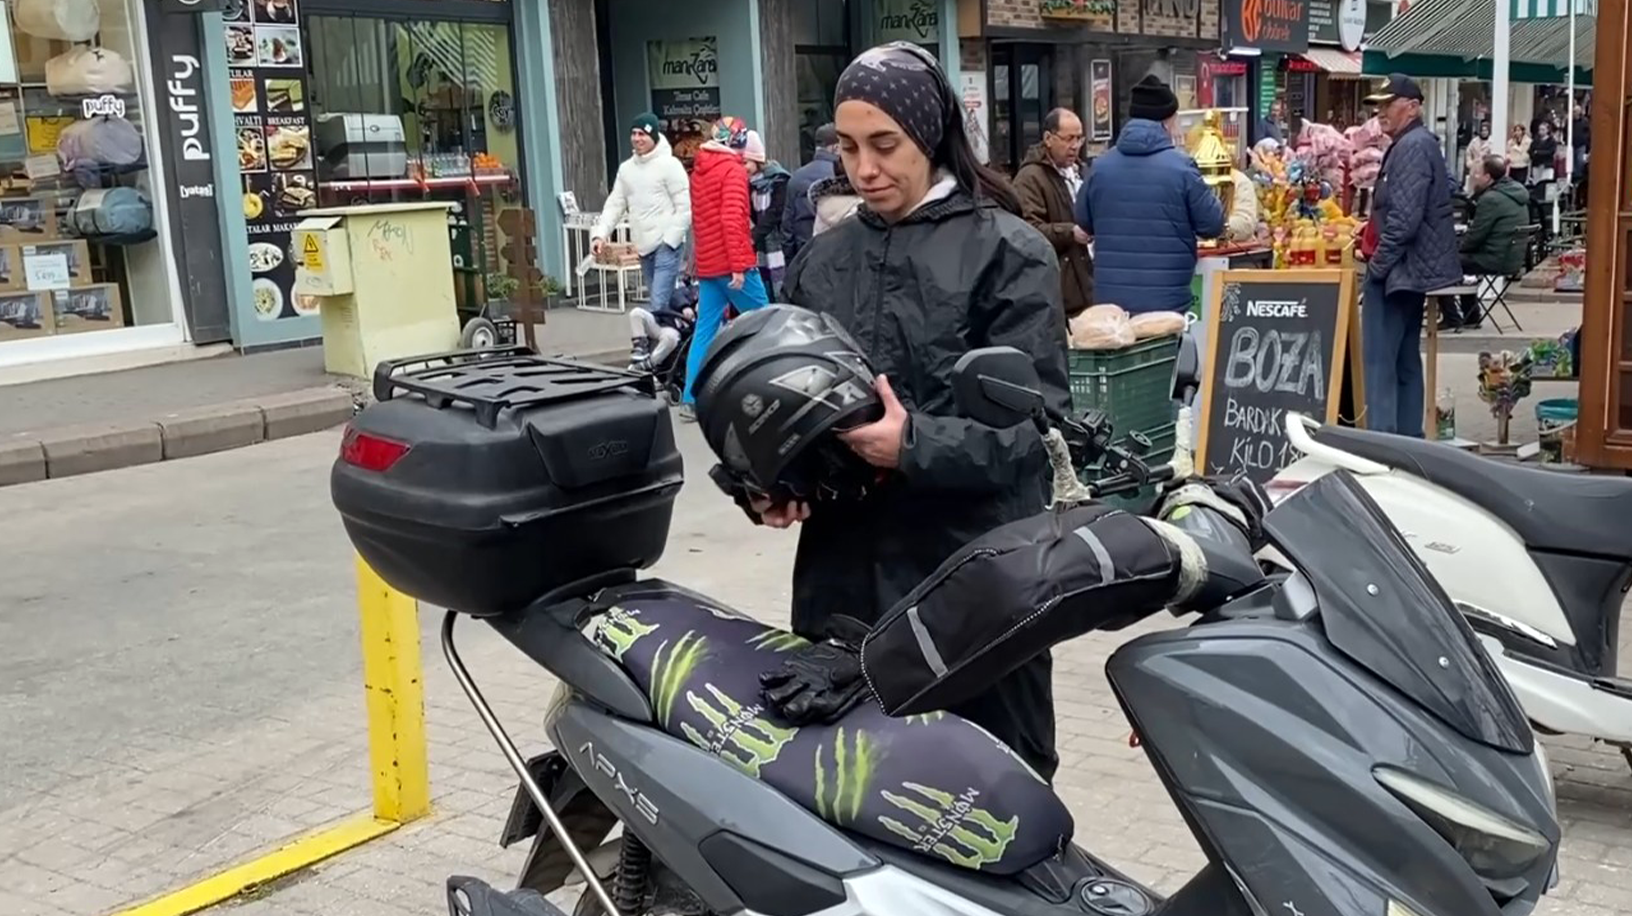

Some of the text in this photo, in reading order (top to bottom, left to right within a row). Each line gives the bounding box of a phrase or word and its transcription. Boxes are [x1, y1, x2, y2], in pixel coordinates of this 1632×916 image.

[85, 97, 123, 116] puffy
[167, 55, 210, 160] puffy
[267, 117, 305, 125] BREAKFAST
[1246, 297, 1307, 317] NESCAFÉ
[1224, 326, 1324, 400] BOZA
[1224, 398, 1282, 437] BARDAK
